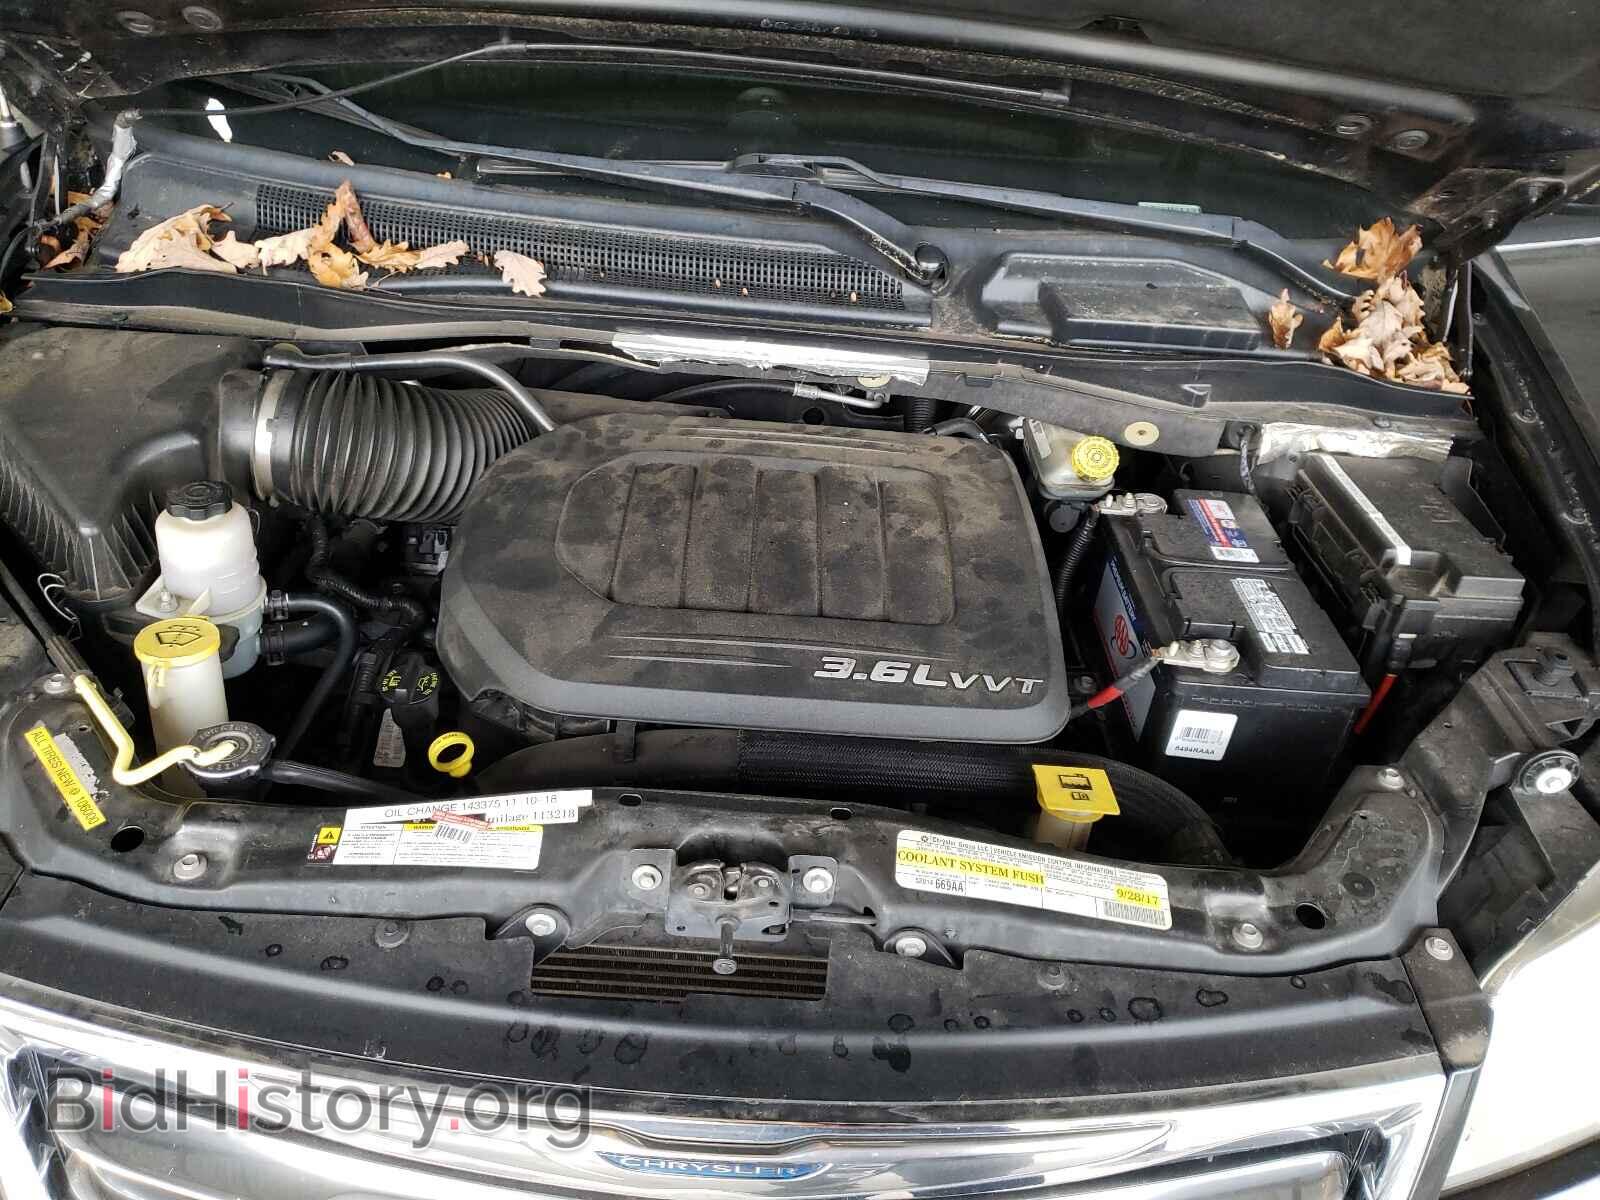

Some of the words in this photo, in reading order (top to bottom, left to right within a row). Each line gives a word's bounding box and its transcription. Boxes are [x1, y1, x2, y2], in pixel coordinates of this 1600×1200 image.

[31, 730, 46, 746] ALL
[42, 743, 63, 769] TIRES
[55, 765, 76, 789] NEW
[384, 808, 405, 818] OIL
[406, 803, 457, 817] CHANGE
[461, 798, 502, 812] 143375
[532, 807, 576, 821] 113218
[993, 847, 1017, 857] VEHICLE
[1018, 851, 1047, 863] EMISSION
[1047, 857, 1073, 869] CONTROL
[1074, 862, 1115, 876] INFORMATION
[897, 849, 957, 869] COOLANT
[959, 859, 1009, 879] SYSTEM
[1012, 869, 1045, 885] FUSH
[1115, 888, 1160, 906] 9/28/17
[619, 1156, 800, 1176] CHRYSLER
